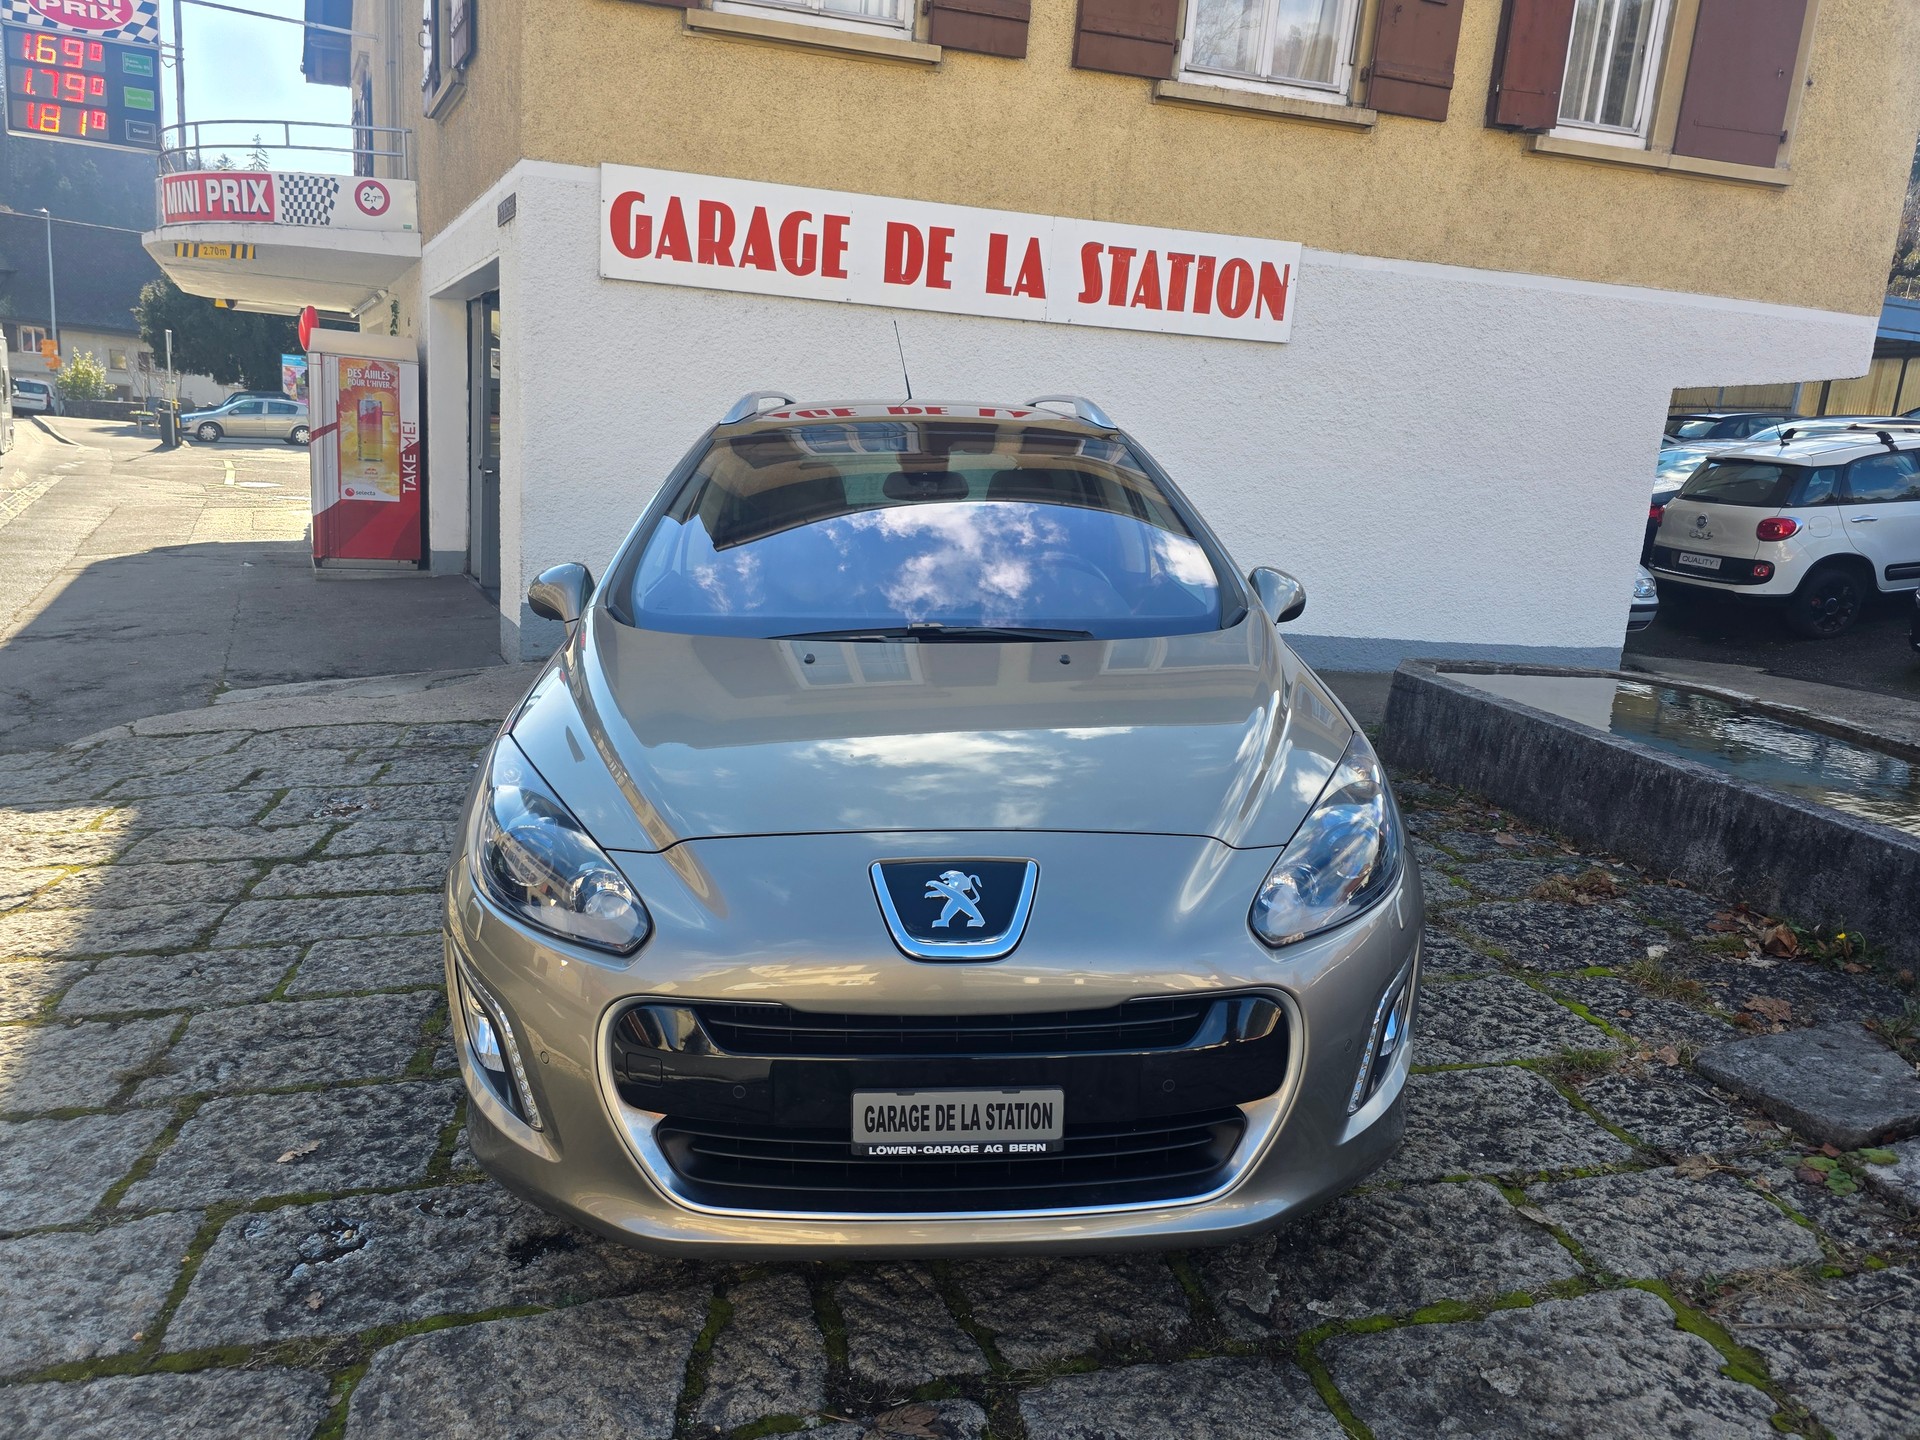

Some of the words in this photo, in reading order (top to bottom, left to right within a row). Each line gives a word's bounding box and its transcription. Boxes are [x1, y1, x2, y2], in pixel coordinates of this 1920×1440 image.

[39, 0, 123, 23] PRIX
[166, 180, 200, 214] MINI
[205, 179, 270, 214] PRIX
[609, 191, 851, 279] GARAGE
[884, 221, 956, 290] DE
[985, 232, 1047, 299] LA
[1077, 241, 1291, 322] STATION
[347, 368, 362, 378] DES
[347, 378, 366, 387] POUR
[402, 421, 416, 450] ME!
[402, 453, 417, 494] TAKE
[355, 489, 377, 497] selecta
[1682, 555, 1714, 566] QUALITY
[864, 1104, 931, 1133] GARAGE
[935, 1103, 956, 1132] DE
[960, 1103, 981, 1131] LA
[985, 1102, 1054, 1131] STATION
[868, 1144, 979, 1156] LÖWEN-GARAGE
[984, 1144, 1004, 1153] AG
[1009, 1143, 1047, 1153] BERN
